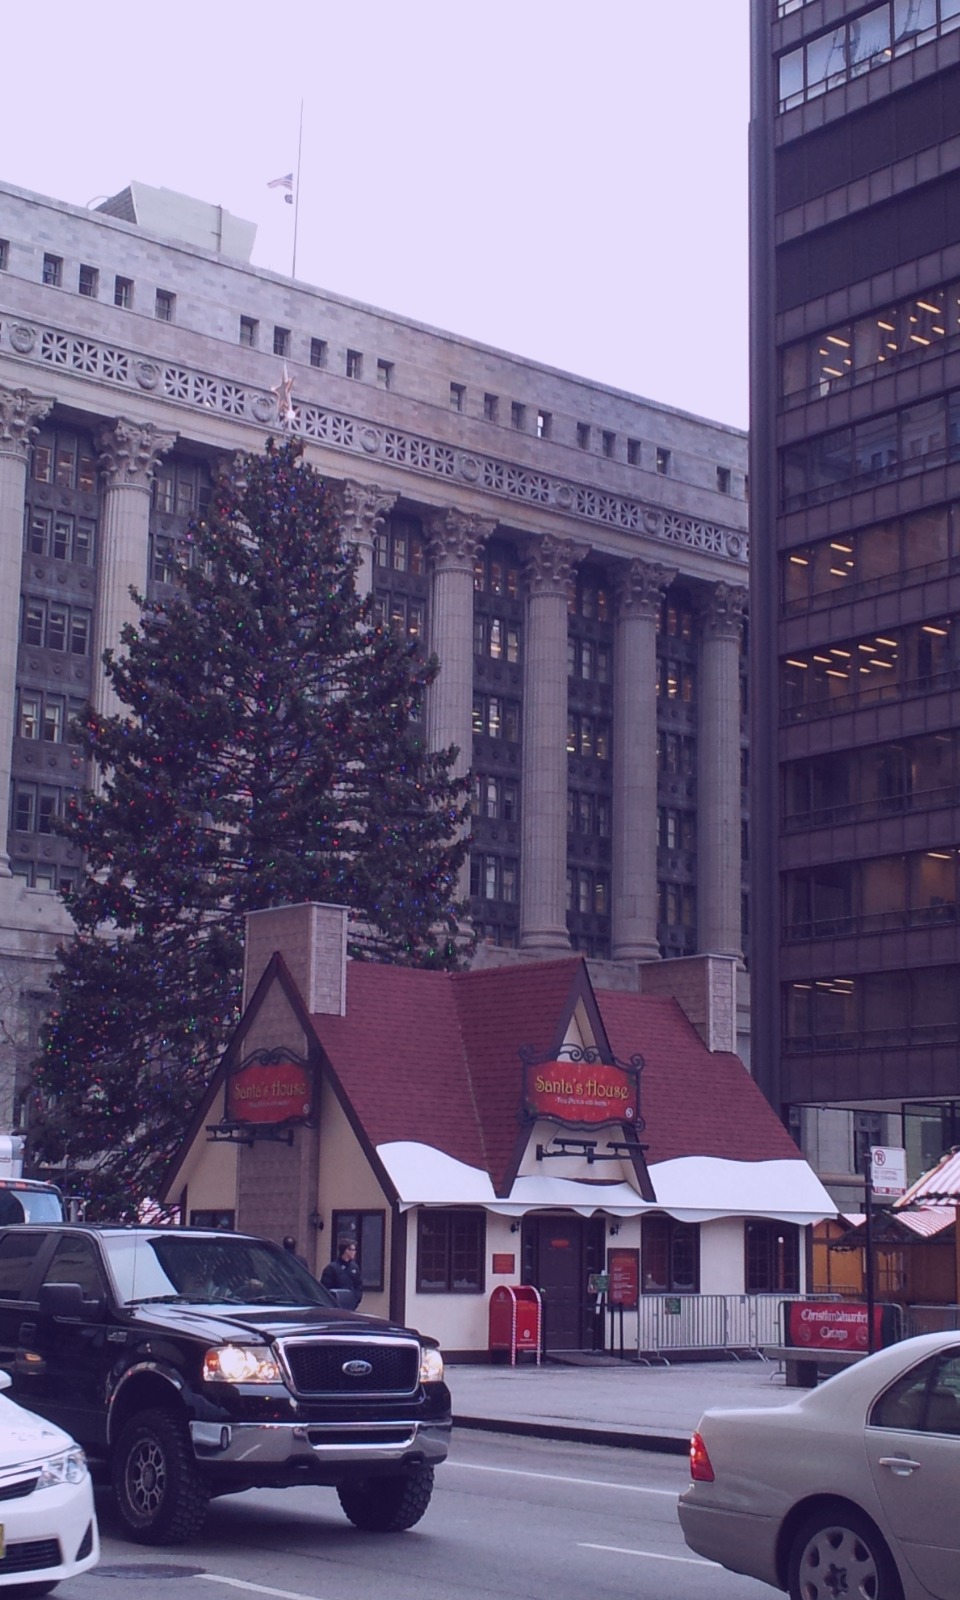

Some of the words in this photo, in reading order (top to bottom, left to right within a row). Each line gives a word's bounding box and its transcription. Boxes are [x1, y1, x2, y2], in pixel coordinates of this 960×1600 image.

[235, 1083, 269, 1099] Santa's
[272, 1080, 306, 1097] House
[535, 1075, 583, 1095] Santa's
[586, 1079, 629, 1100] House
